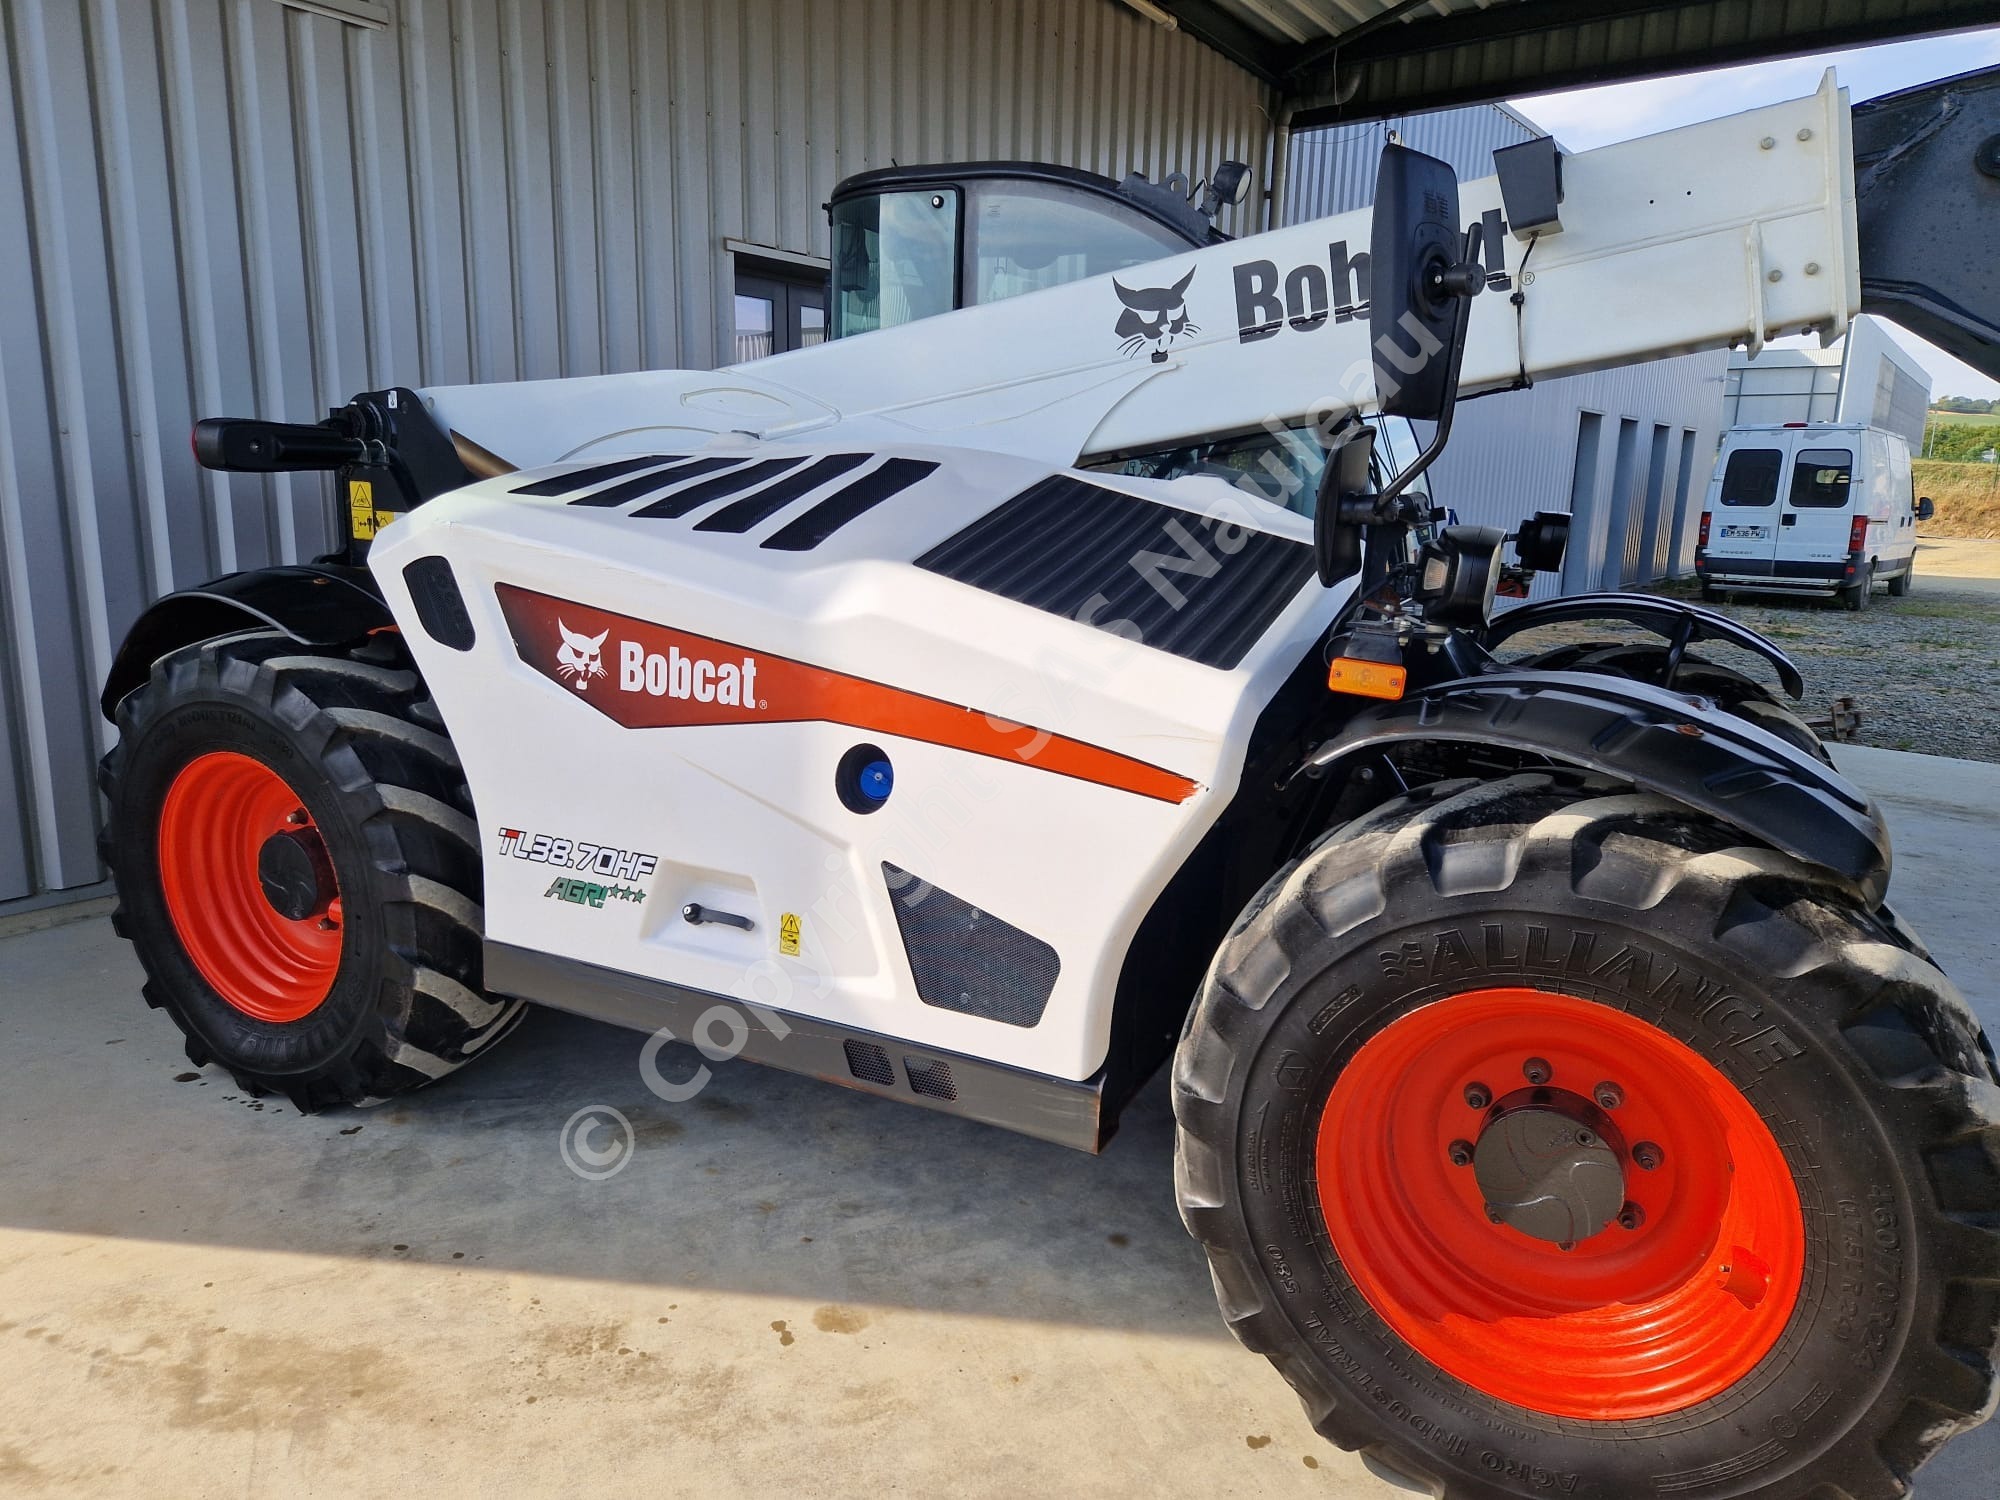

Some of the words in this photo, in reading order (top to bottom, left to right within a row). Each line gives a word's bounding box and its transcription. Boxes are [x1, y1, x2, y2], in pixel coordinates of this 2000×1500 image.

[1233, 208, 1512, 344] Bobt
[620, 640, 757, 709] Bobcat
[499, 827, 658, 881] TL38.70HF
[1427, 922, 1808, 1072] ALLIANCE
[1264, 1244, 1300, 1295] 580
[1303, 1308, 1473, 1457] INDUSTRIAL
[1480, 1450, 1581, 1494] AGRO
